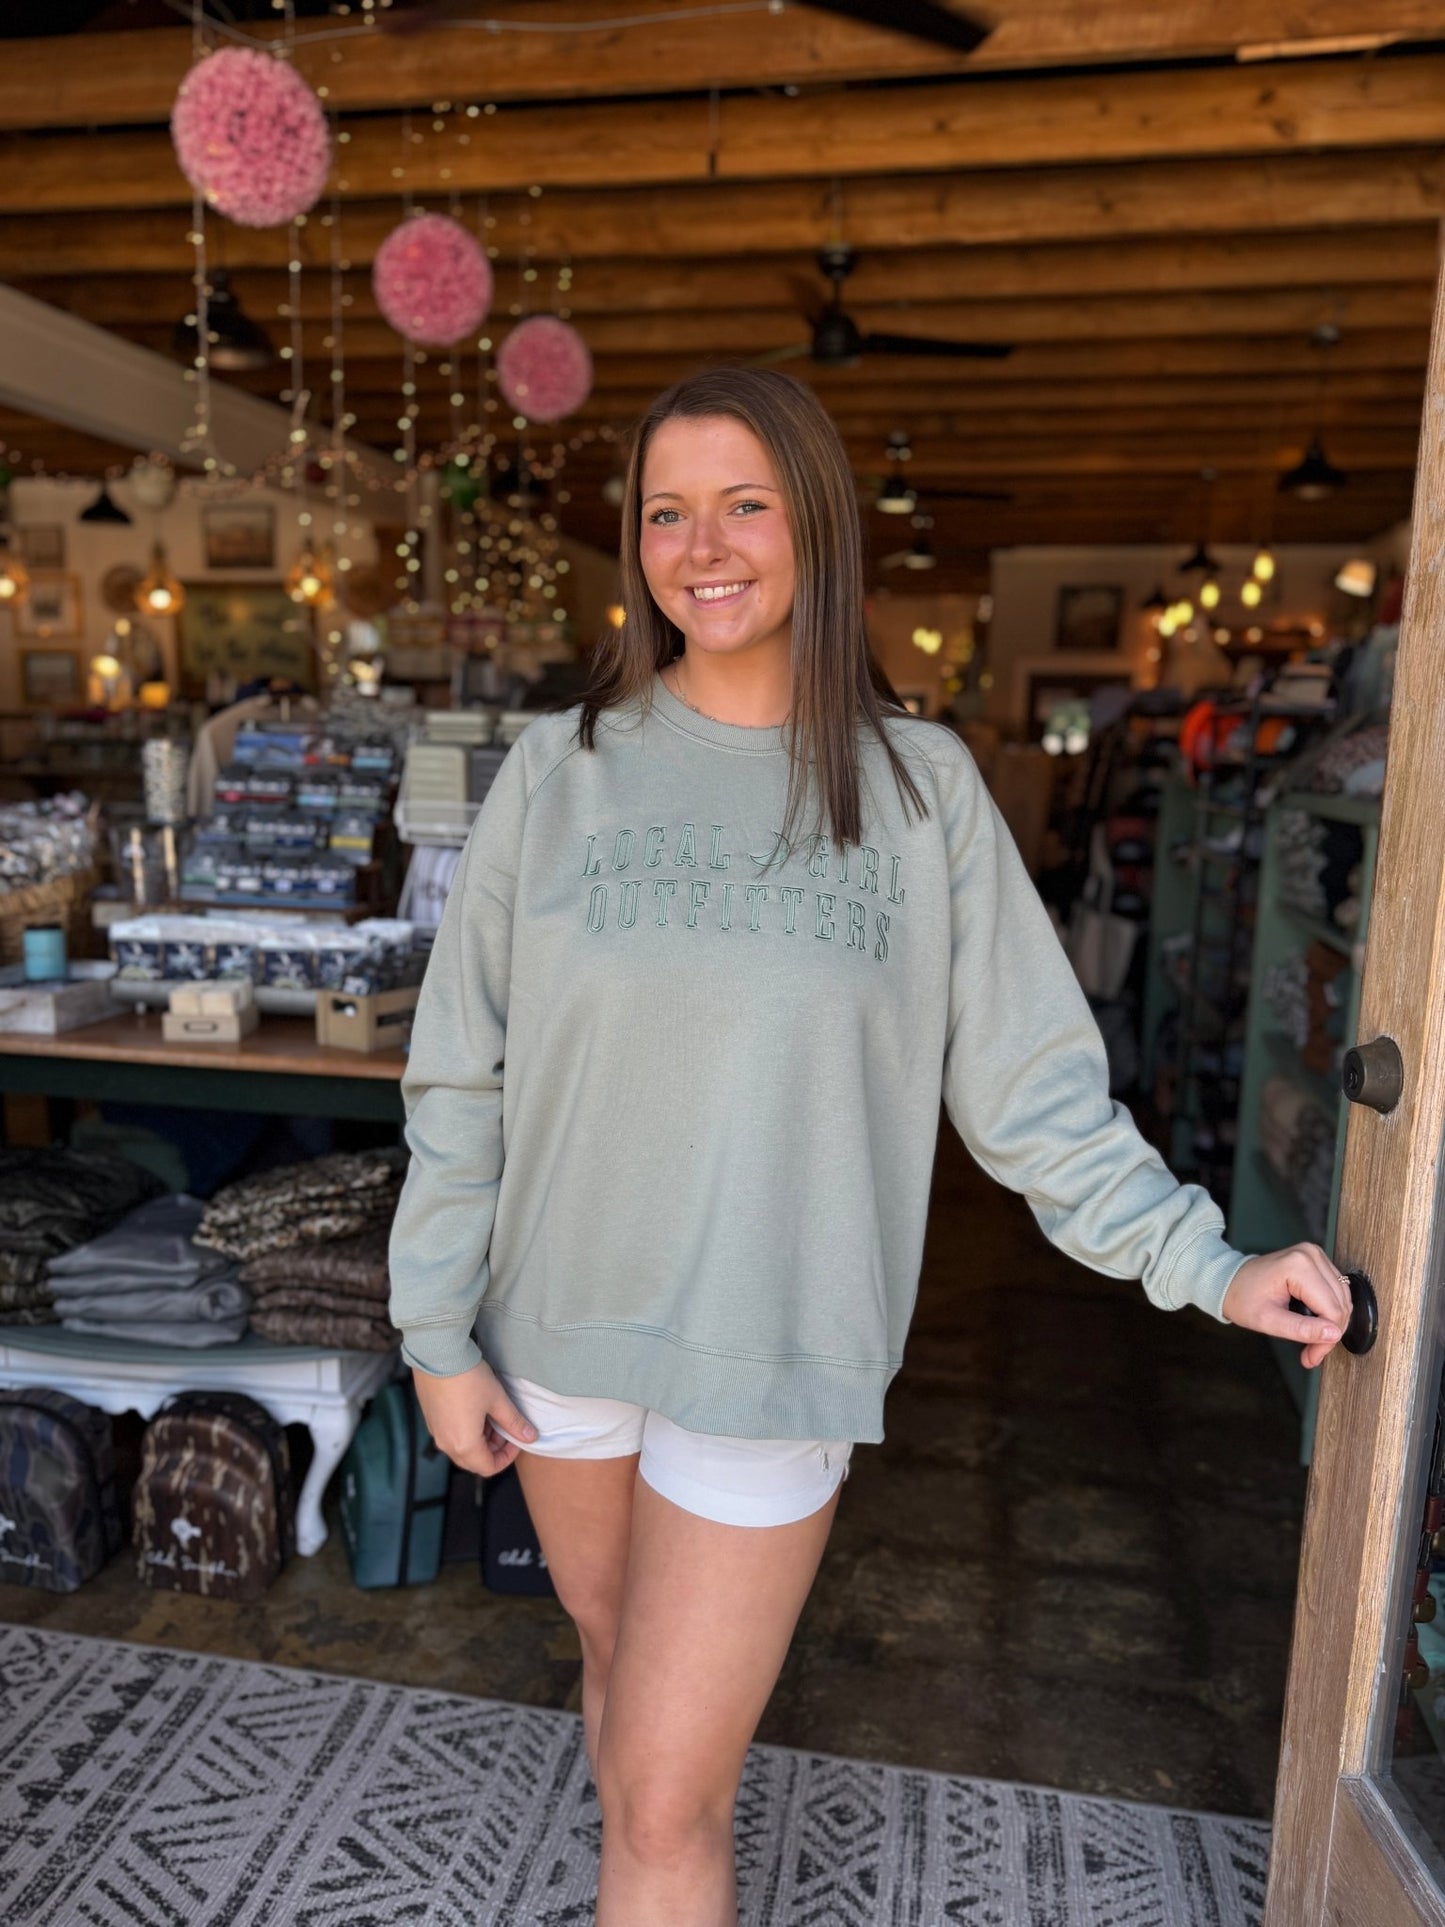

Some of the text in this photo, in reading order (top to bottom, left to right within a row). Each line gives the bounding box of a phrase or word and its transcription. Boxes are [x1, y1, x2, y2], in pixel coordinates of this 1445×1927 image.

[583, 823, 905, 905] LOCAL GIRL
[586, 879, 890, 963] OUTFITTERS
